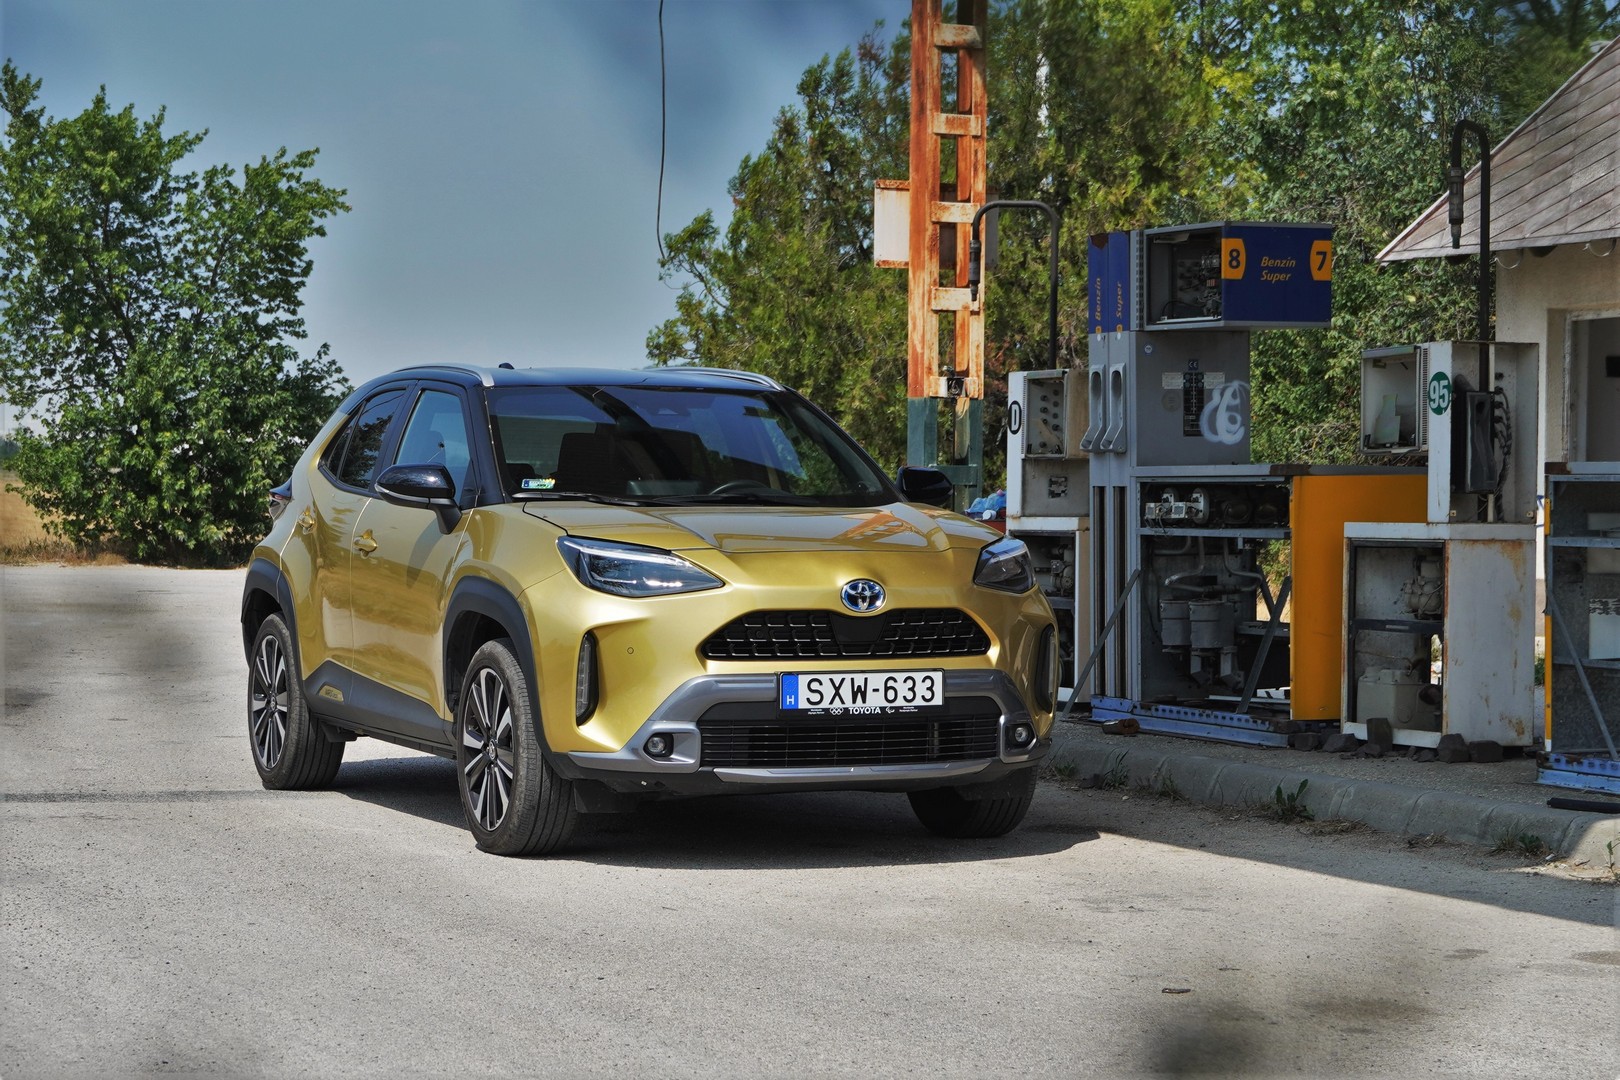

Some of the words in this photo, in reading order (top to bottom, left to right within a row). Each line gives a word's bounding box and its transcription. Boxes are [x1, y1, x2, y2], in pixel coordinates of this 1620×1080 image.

[1228, 248, 1240, 270] 8
[1260, 256, 1296, 268] Benzin
[1315, 251, 1327, 271] 7
[1260, 270, 1291, 284] Super
[1115, 281, 1123, 319] Super
[1429, 379, 1449, 409] 95
[1011, 404, 1020, 431] D
[786, 695, 795, 705] H
[805, 675, 935, 706] SXW-633
[848, 706, 881, 715] TOYOTA
